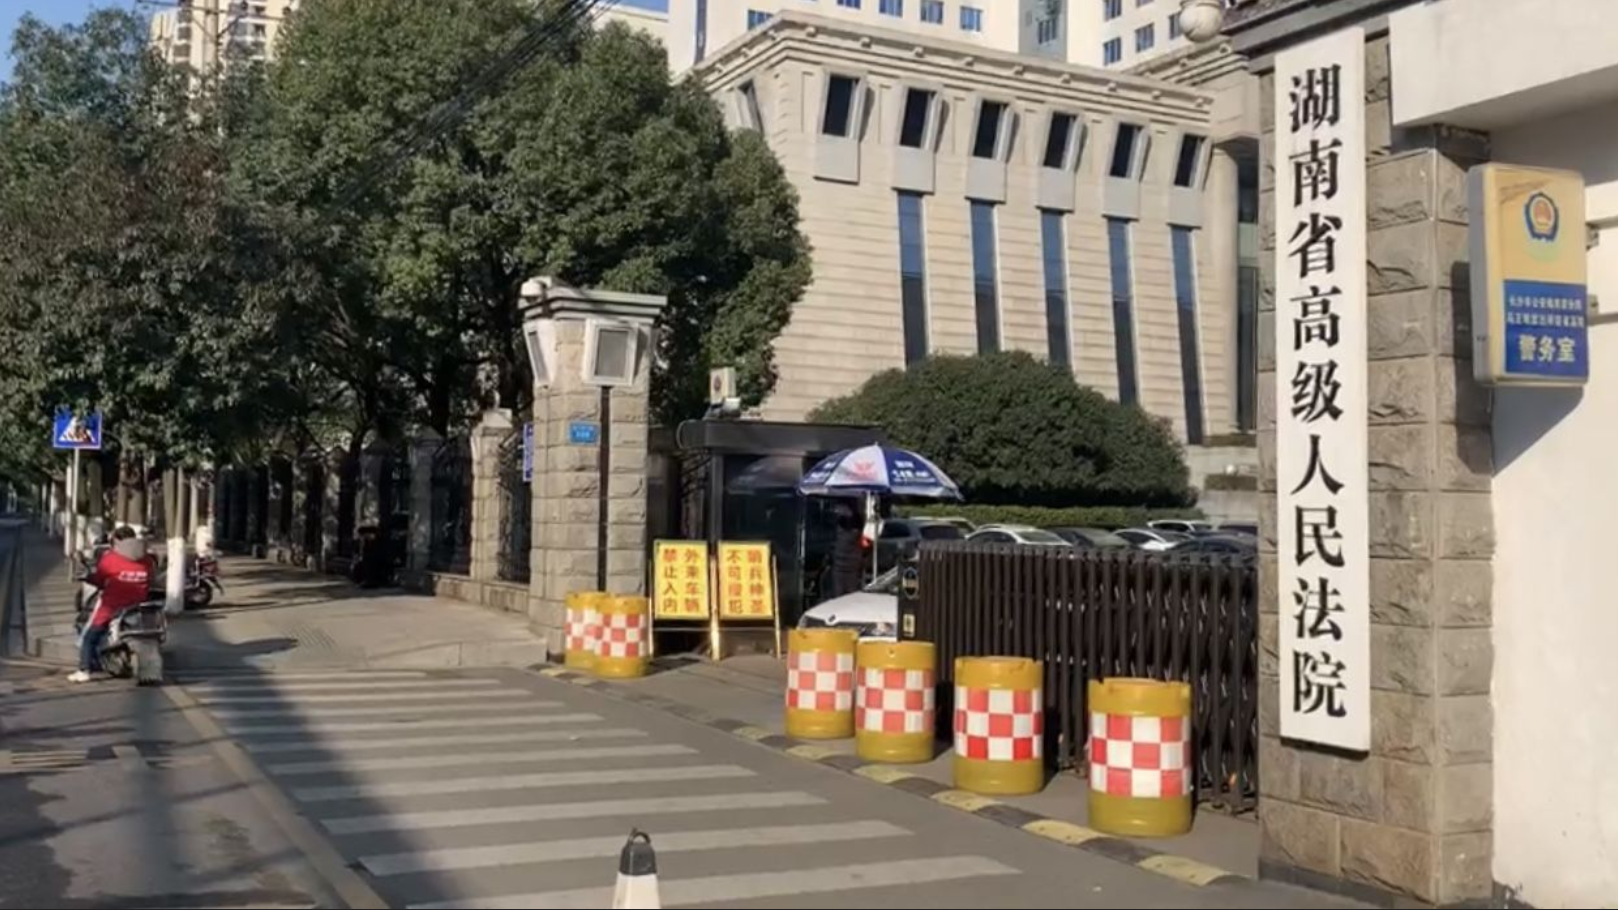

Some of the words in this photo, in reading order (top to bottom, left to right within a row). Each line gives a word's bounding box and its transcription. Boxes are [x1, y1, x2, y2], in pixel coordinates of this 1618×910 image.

[1518, 333, 1576, 363] 警务室
[1288, 63, 1347, 718] 湖南省高级人民法院
[663, 548, 678, 613] 禁止入内
